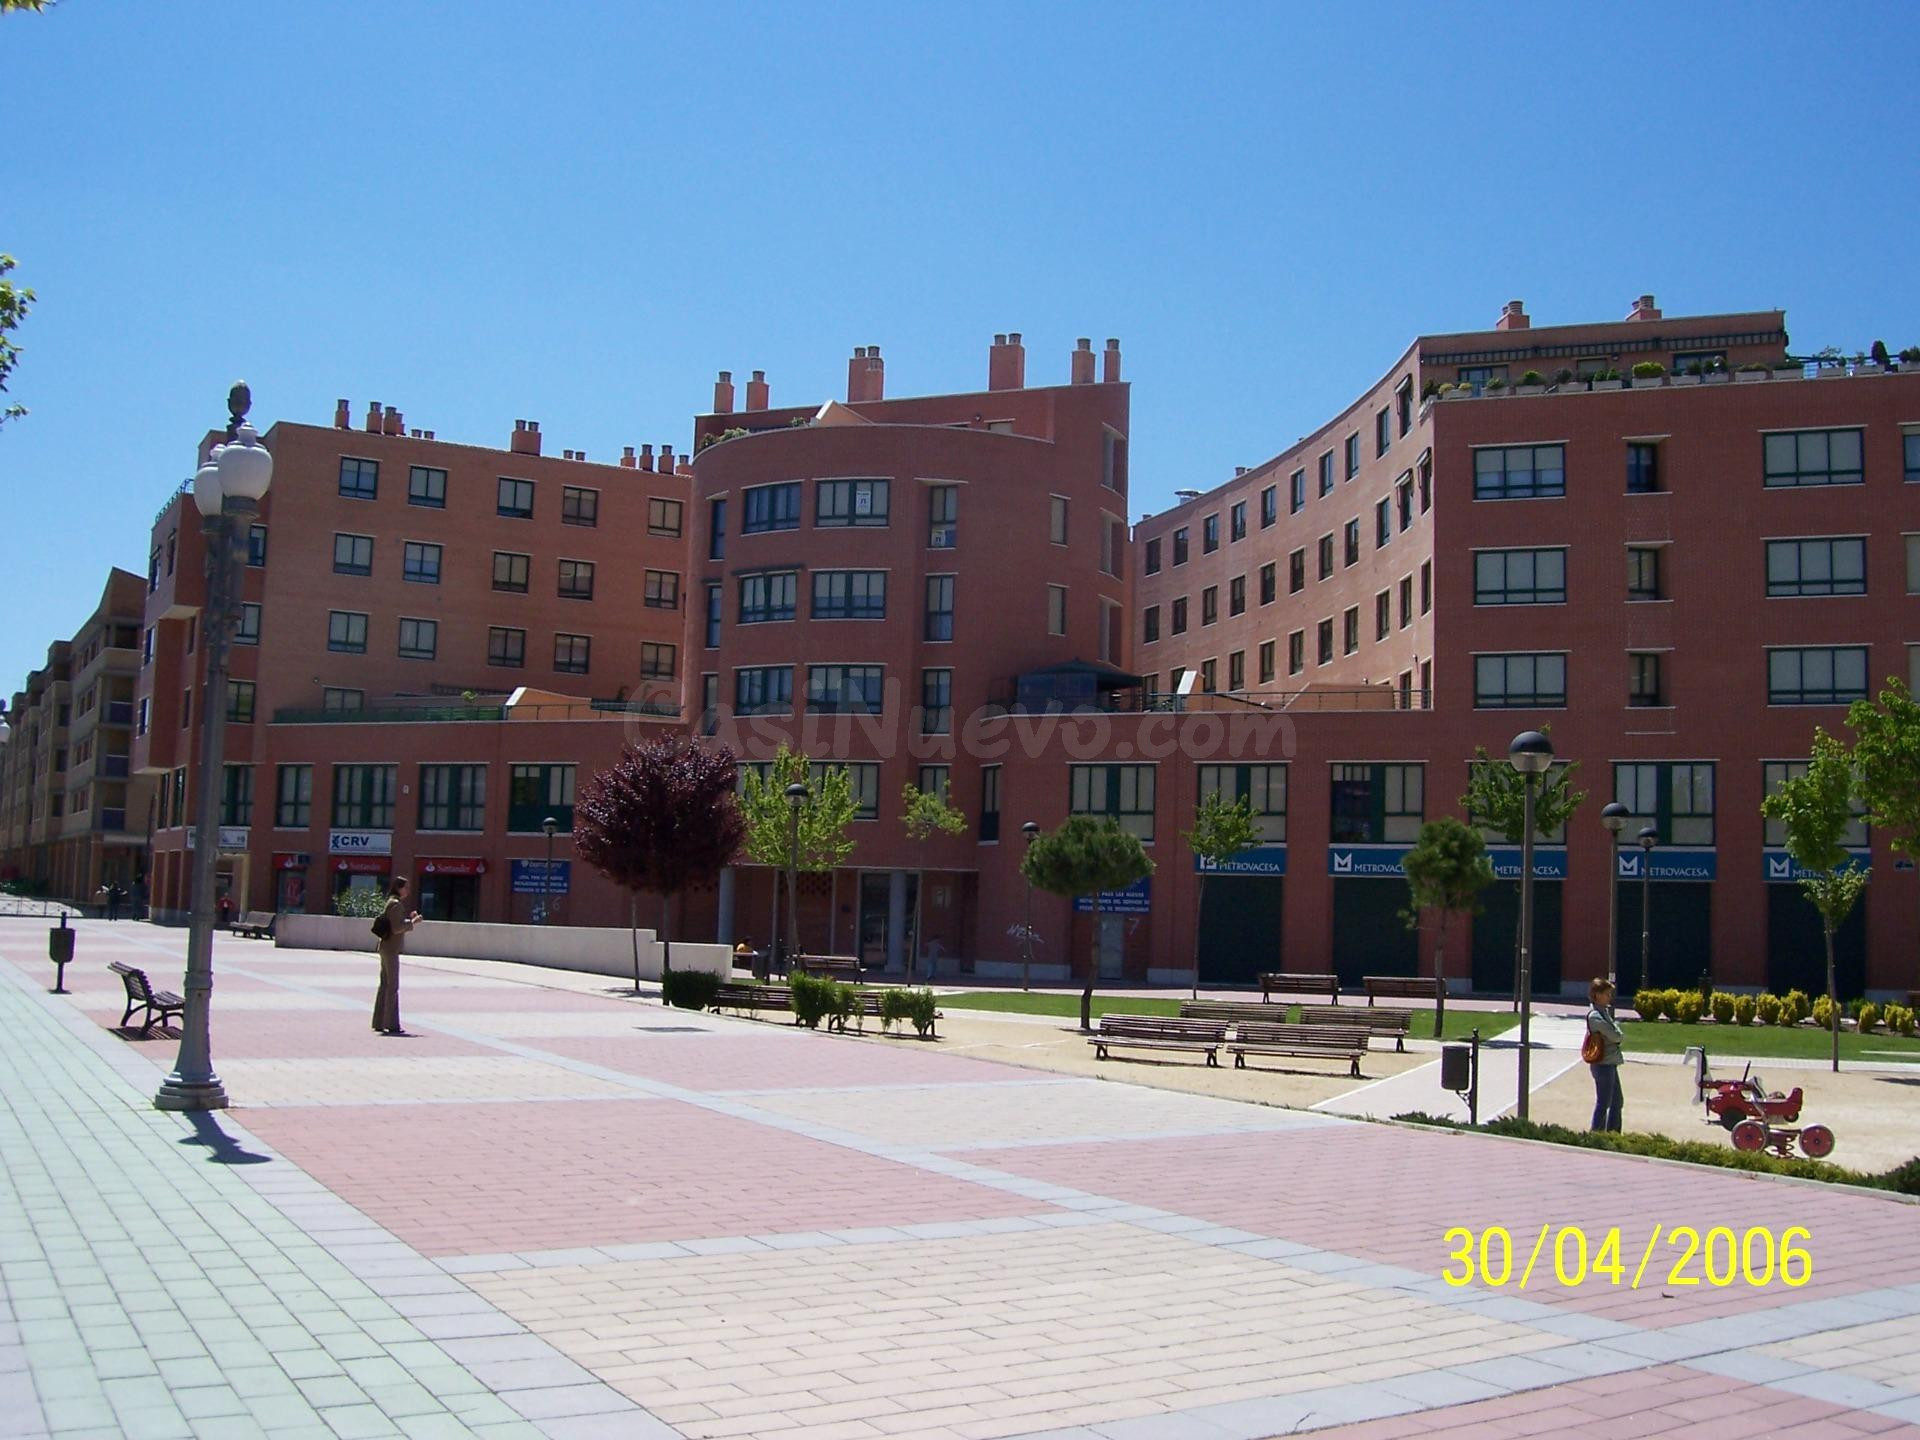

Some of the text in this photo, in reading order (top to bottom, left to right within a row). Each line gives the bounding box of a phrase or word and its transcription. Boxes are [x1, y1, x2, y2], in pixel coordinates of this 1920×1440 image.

[341, 835, 370, 846] CRV
[350, 861, 381, 871] Santander
[437, 863, 471, 873] Santander
[1354, 863, 1407, 873] METROVACE
[1494, 865, 1561, 876] METRACESA
